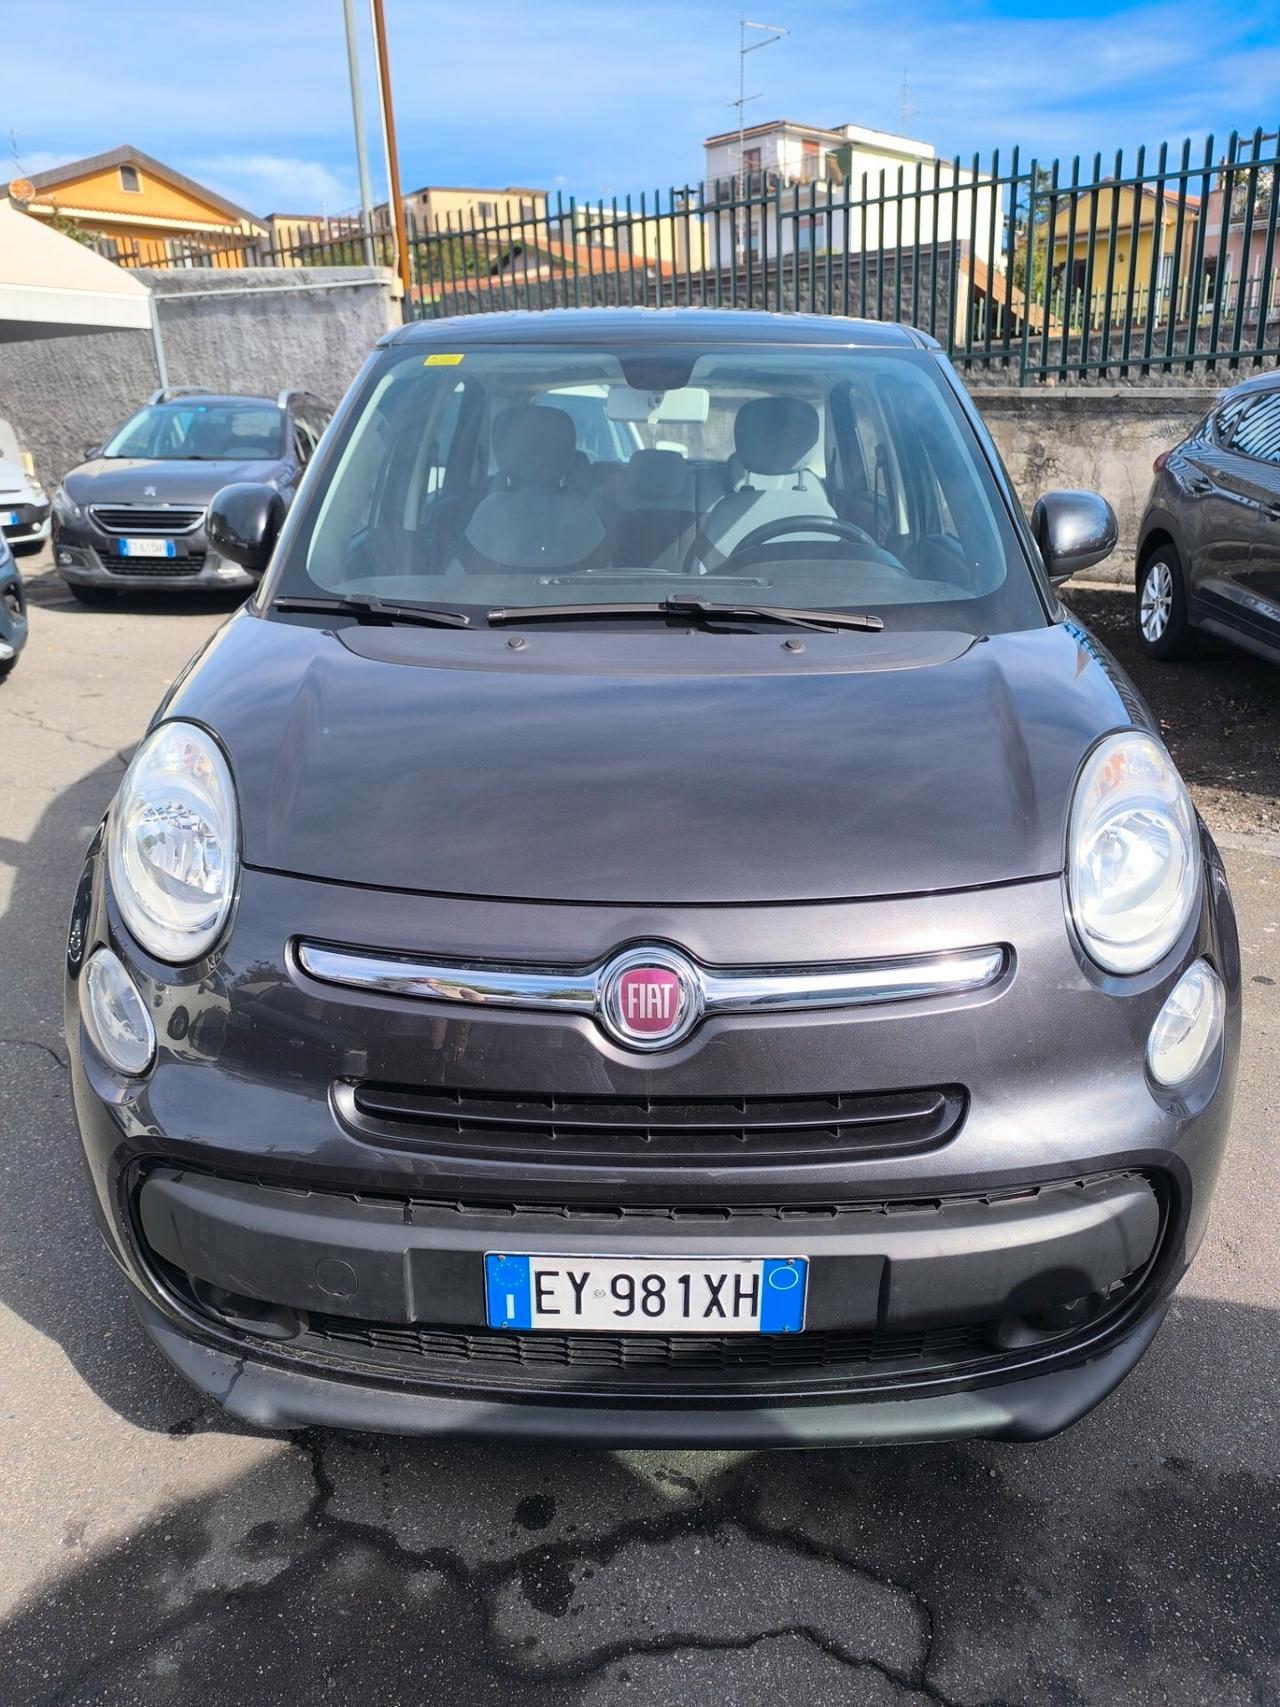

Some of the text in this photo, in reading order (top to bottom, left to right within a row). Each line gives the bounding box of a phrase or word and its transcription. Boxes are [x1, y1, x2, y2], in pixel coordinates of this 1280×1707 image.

[627, 983, 674, 1019] FIAT
[534, 1270, 760, 1318] EY 981XH
